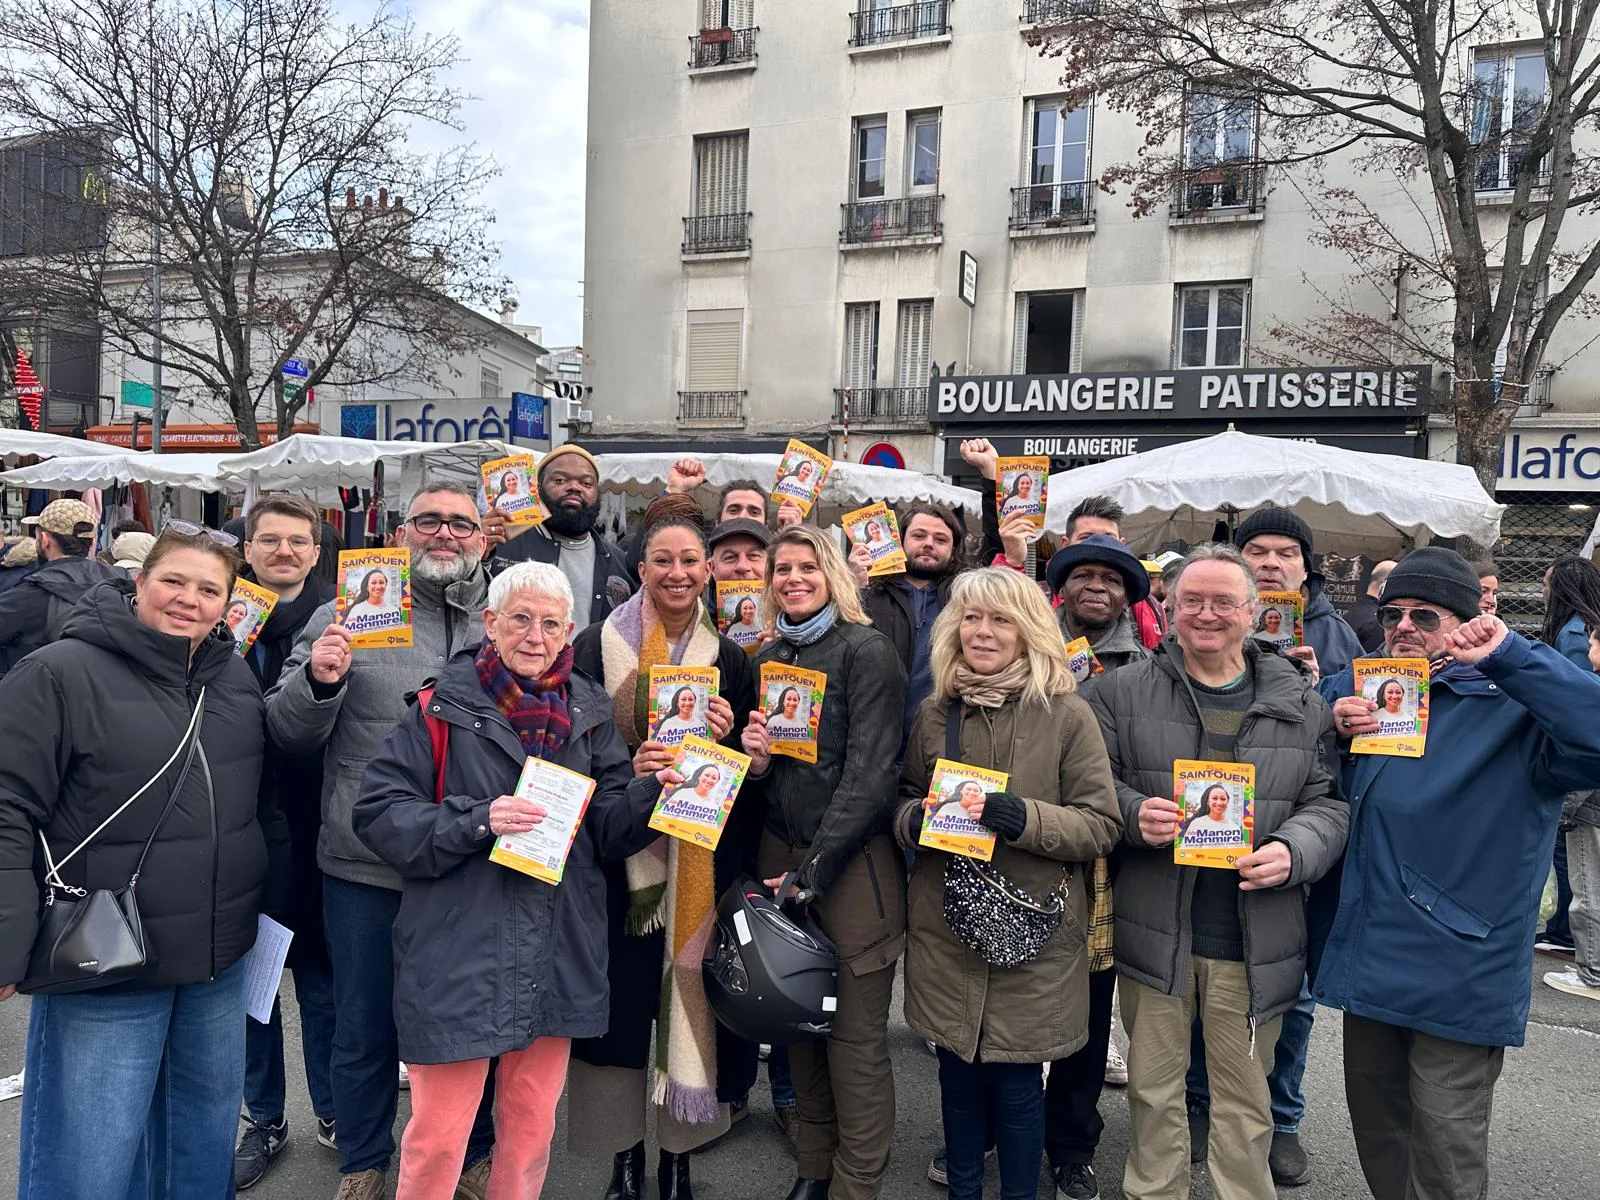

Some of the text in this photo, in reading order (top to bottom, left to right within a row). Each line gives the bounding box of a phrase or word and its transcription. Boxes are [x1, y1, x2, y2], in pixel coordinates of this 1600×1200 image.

[937, 370, 1419, 413] BOULANGERIE PATISSERIE
[517, 407, 544, 424] laforêt
[1023, 438, 1138, 456] BOULANGERIE
[720, 587, 765, 596] SAINT-OUE
[345, 613, 404, 630] Monmirel
[357, 611, 399, 623] Manon
[734, 631, 761, 639] Mano
[667, 726, 705, 737] Manon
[663, 803, 721, 822] Monmirel
[677, 800, 718, 815] Manon
[945, 815, 980, 826] Mano
[1184, 826, 1244, 844] Monmirel
[1196, 829, 1240, 837] Manon
